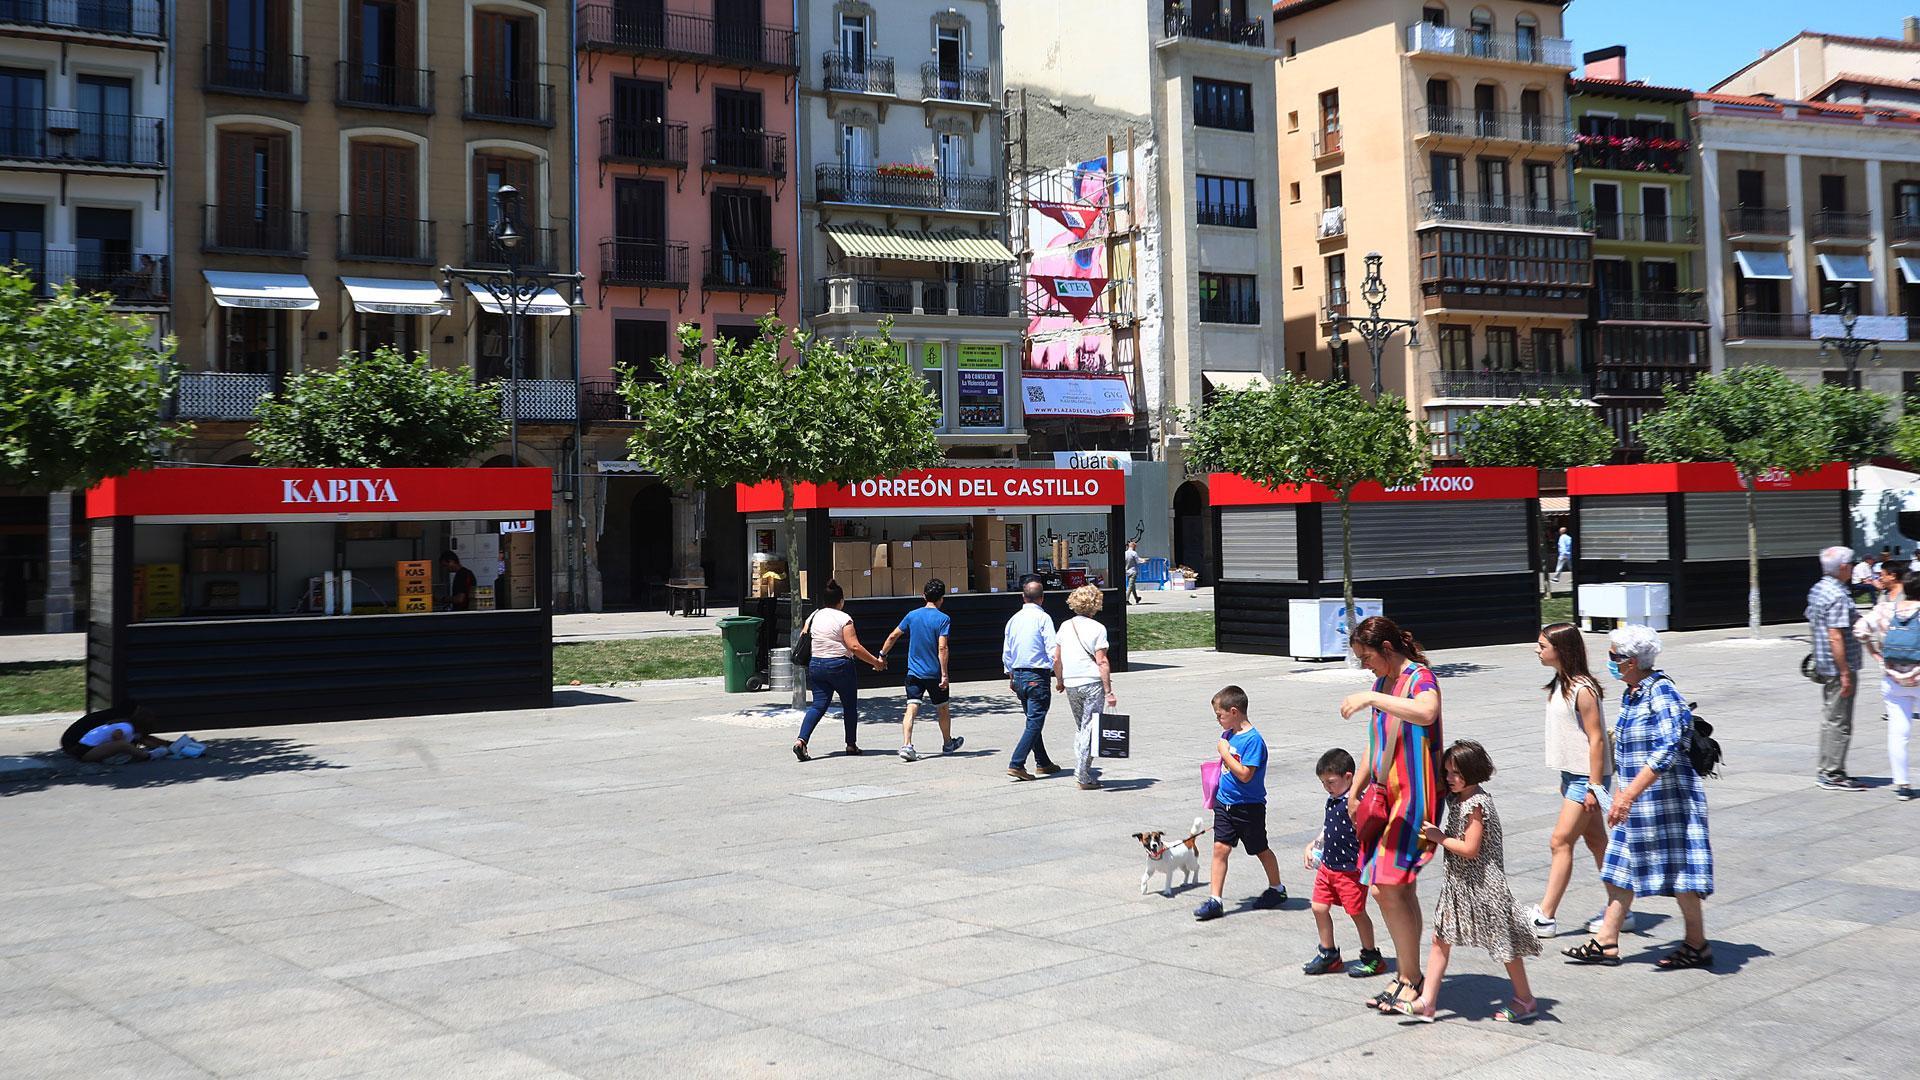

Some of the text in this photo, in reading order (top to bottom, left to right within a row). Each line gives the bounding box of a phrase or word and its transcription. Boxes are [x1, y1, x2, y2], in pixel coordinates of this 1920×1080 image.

[959, 479, 998, 496] DEL
[1003, 478, 1099, 496] CASTILLO
[1420, 477, 1474, 492] TXOKO
[281, 479, 399, 503] KABIYA
[405, 568, 425, 577] KAS
[406, 585, 426, 594] KAS
[406, 602, 427, 611] KAS
[1103, 729, 1125, 738] BSC
